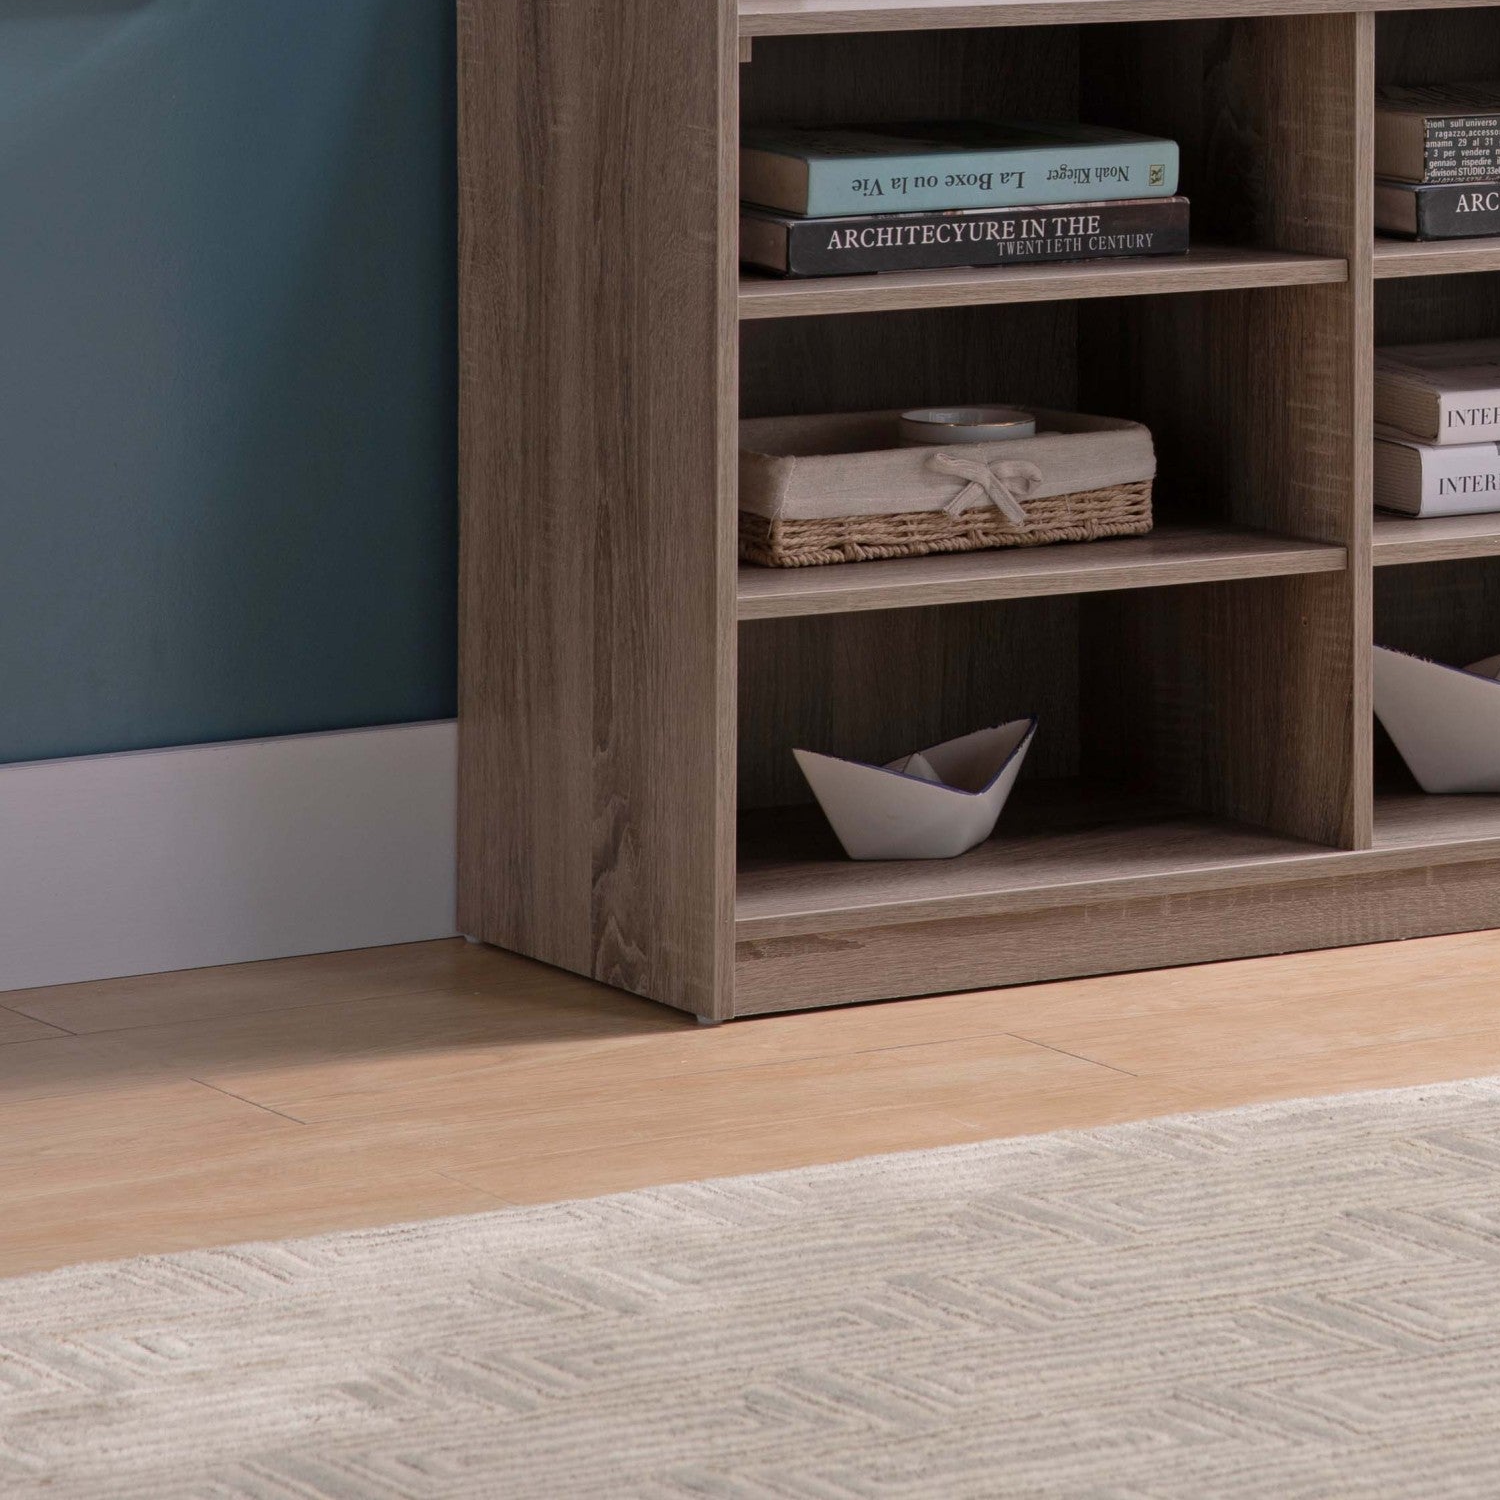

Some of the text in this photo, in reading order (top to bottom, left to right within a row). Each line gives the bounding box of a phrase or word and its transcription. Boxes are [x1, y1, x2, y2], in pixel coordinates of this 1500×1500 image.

[1458, 138, 1467, 148] 29
[1485, 137, 1494, 146] 31
[1433, 149, 1439, 157] 3
[1443, 149, 1456, 158] per
[1461, 147, 1491, 157] vendere
[1429, 159, 1457, 169] gennaio
[1458, 166, 1486, 176] STUDIO
[1046, 163, 1130, 185] Noah Klieger
[851, 171, 1025, 197] La Boxe ou la Vie
[826, 215, 1101, 250] ARCHITECYURE IN THE
[997, 233, 1154, 257] TWENTIETH CENTURY
